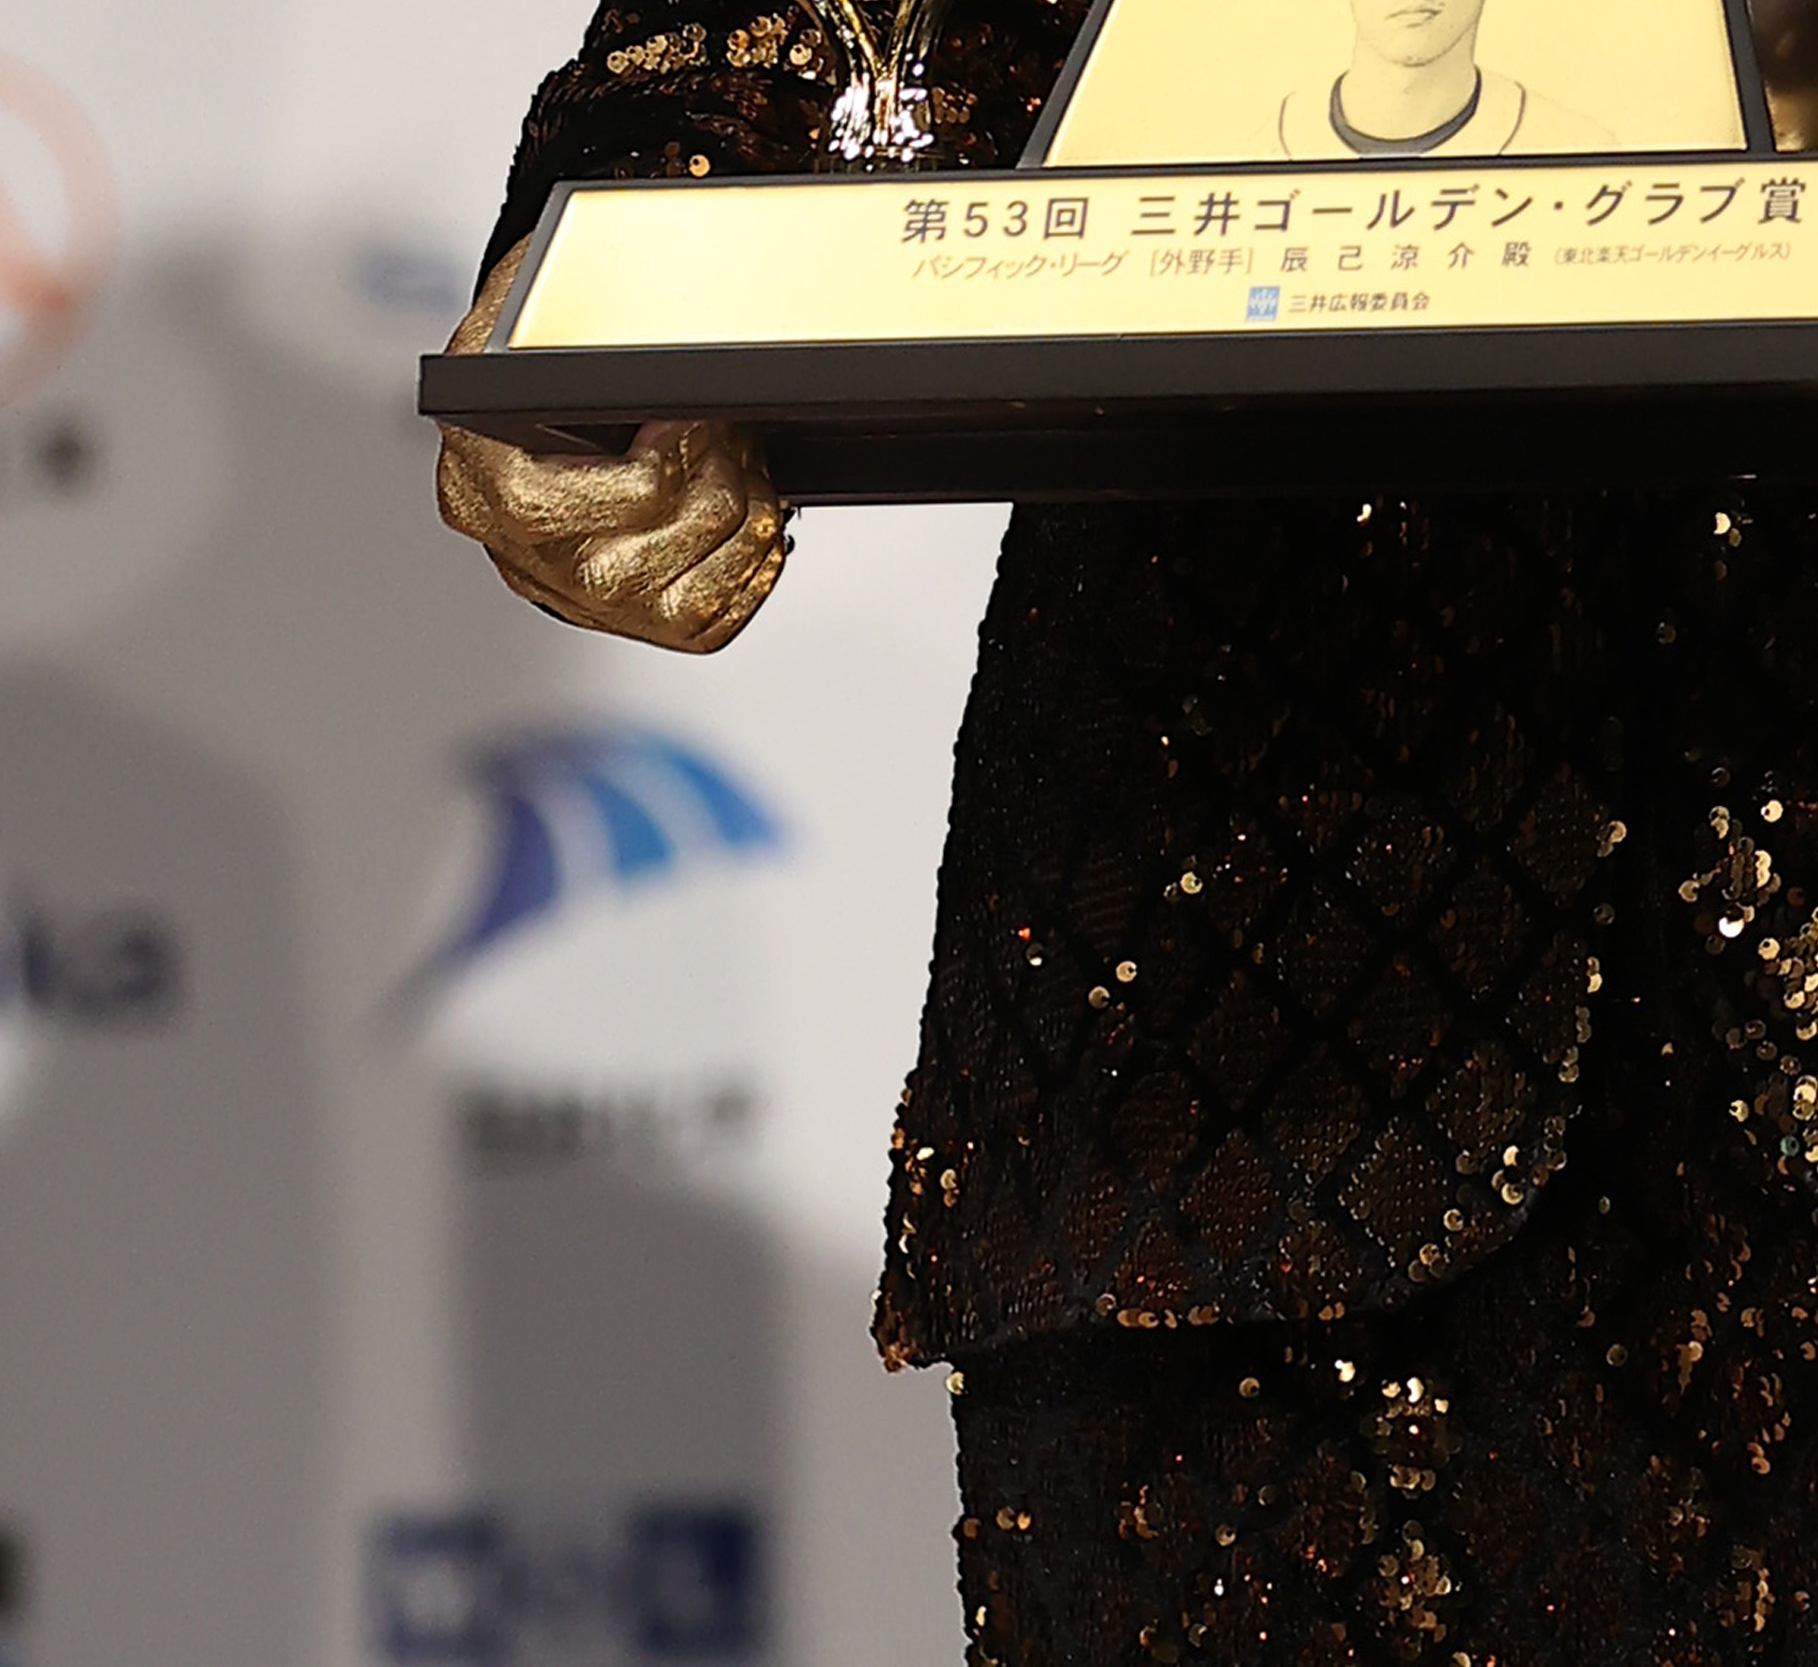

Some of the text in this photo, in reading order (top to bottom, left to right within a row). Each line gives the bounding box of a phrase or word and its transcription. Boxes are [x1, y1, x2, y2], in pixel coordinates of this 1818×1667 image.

[901, 177, 1806, 244] 第53回 三井ゴールデン・グラブ賞
[912, 248, 1131, 280] パシフィック・リーグ
[1288, 291, 1431, 314] 三井広報委員会
